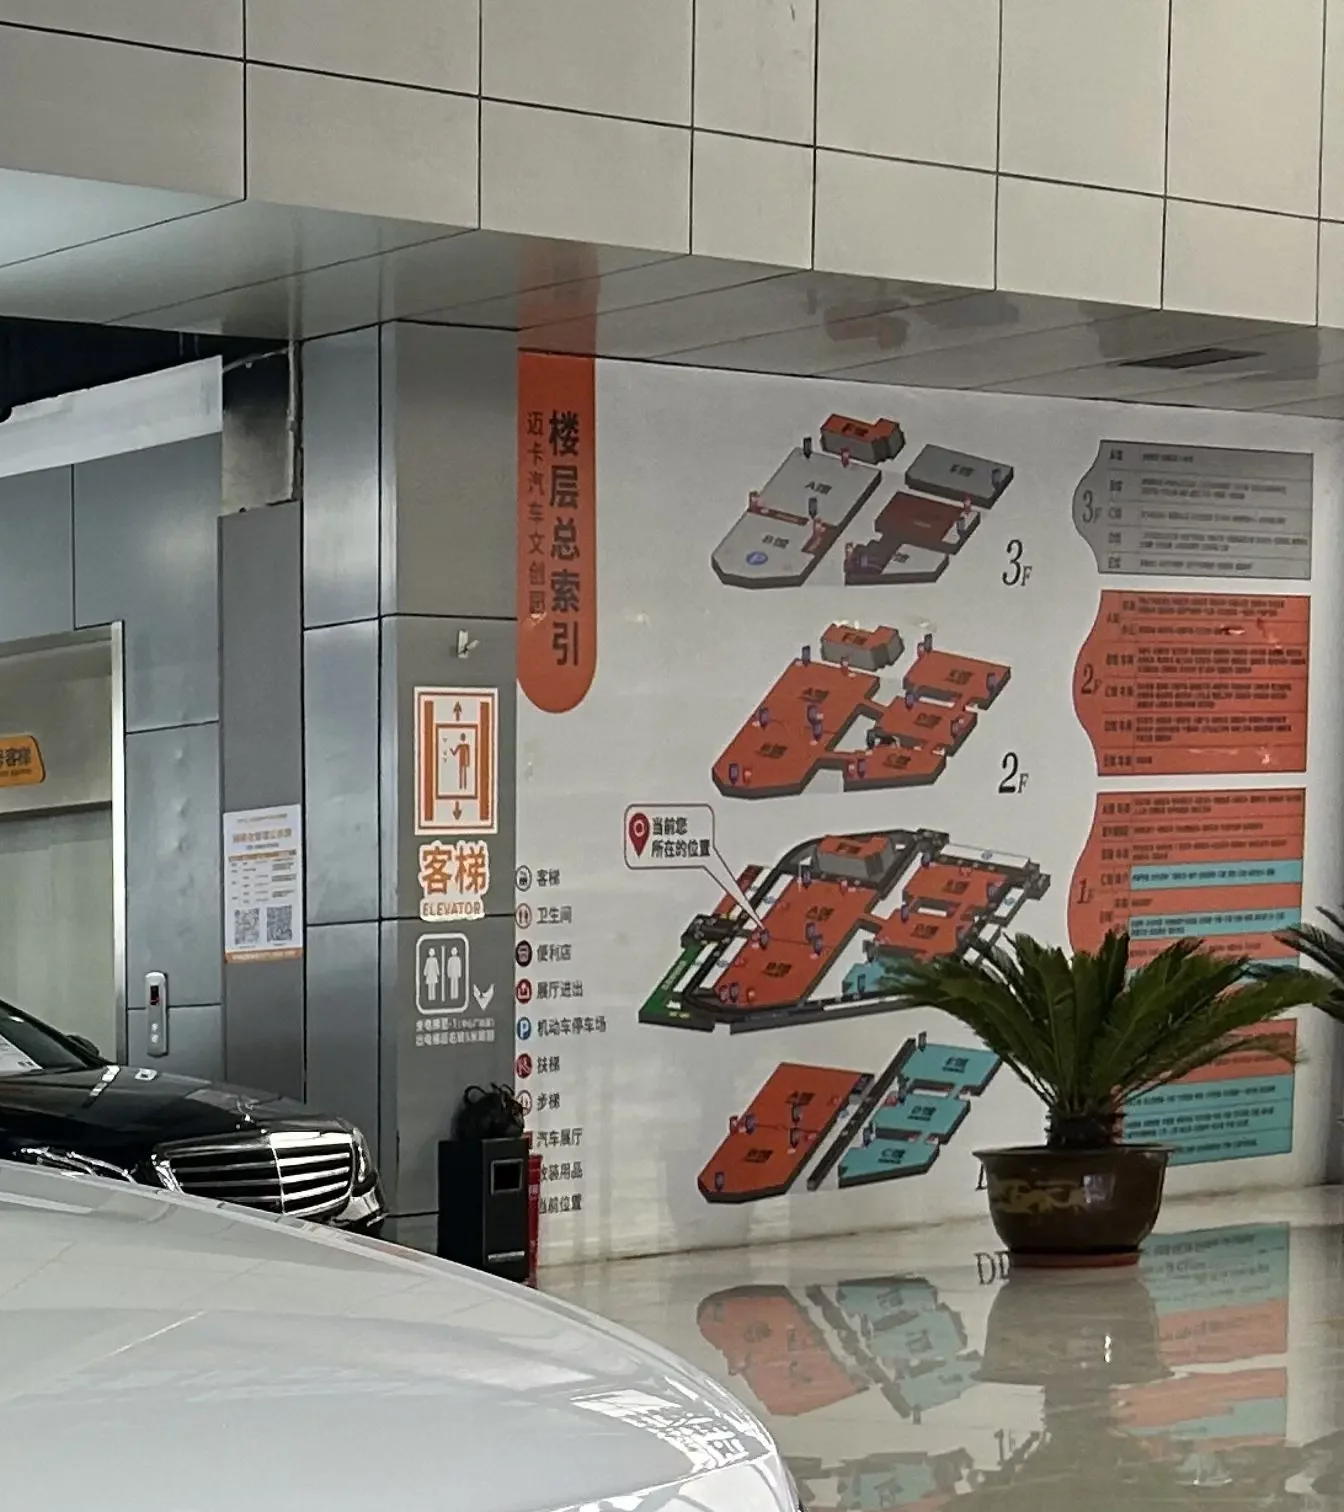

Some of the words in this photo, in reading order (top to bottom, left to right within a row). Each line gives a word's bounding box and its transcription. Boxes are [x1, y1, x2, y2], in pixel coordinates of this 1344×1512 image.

[548, 410, 580, 667] 楼层总索引
[1002, 538, 1032, 588] 3F
[997, 752, 1029, 795] 2F
[652, 816, 688, 836] 当前您
[651, 839, 711, 858] 所在的位置
[422, 845, 487, 895] 客梯
[536, 868, 561, 887] 客梯
[422, 901, 481, 916] ELEVATOR
[536, 905, 573, 924] 卫生间
[536, 943, 572, 962] 便利店
[536, 980, 584, 1000] 展厅进出
[536, 1015, 607, 1037] 机动车停车场
[536, 1055, 561, 1074] 扶梯
[536, 1092, 560, 1111] 步梯
[536, 1127, 583, 1149] 汽车展厅
